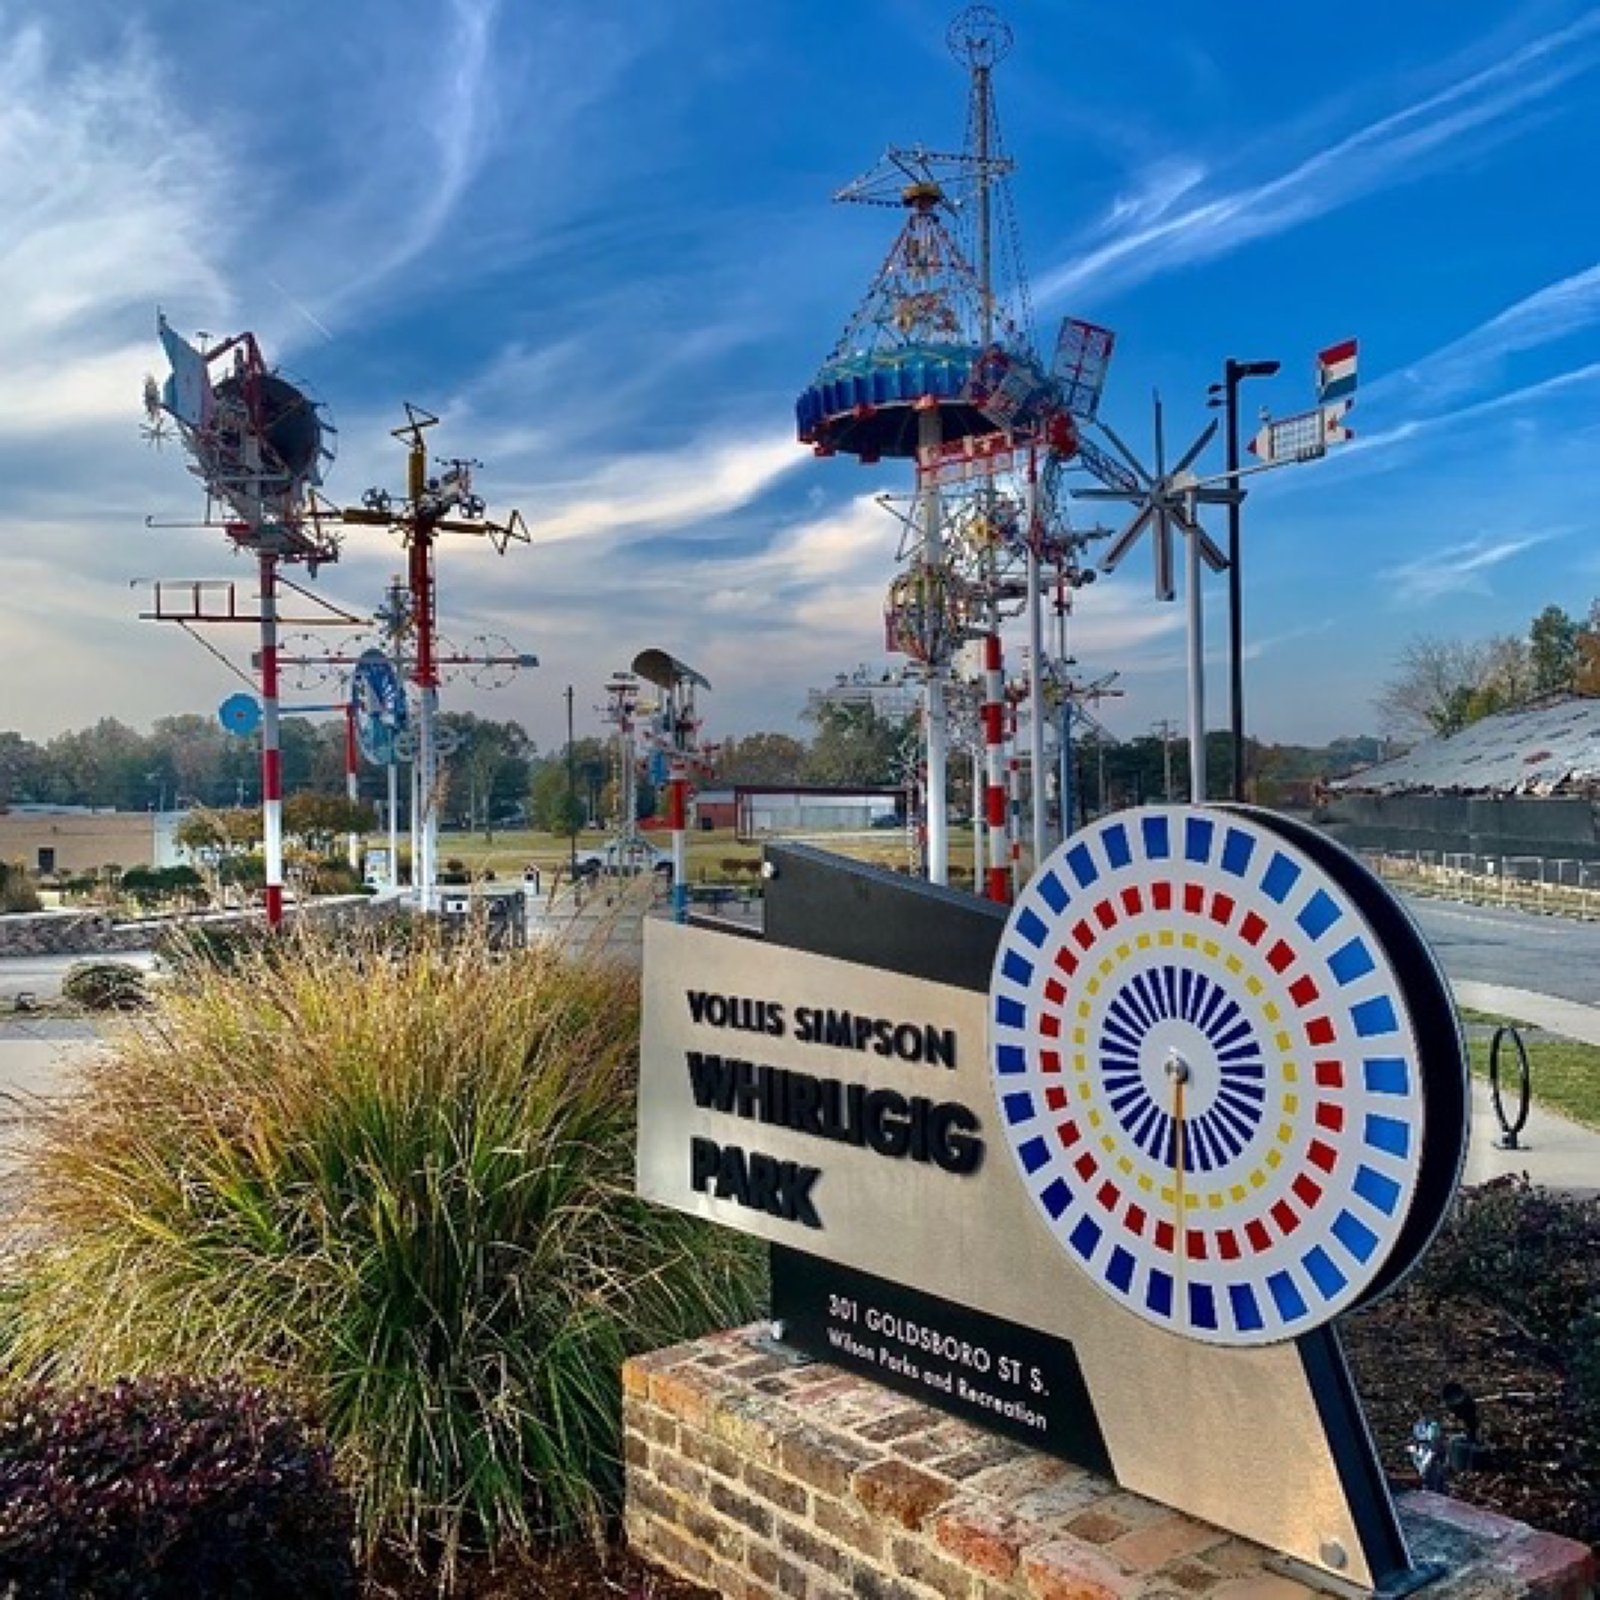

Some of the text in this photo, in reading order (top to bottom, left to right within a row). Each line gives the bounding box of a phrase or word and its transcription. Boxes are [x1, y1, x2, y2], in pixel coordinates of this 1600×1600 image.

[687, 989, 957, 1069] VOLLIS SIMPSON
[685, 1051, 985, 1175] WHIRLIGIG
[690, 1136, 824, 1230] PARK
[827, 1327, 1047, 1431] Wilson Parks and Recreation
[828, 1294, 1050, 1396] 301 GOLDSBORO ST S.
